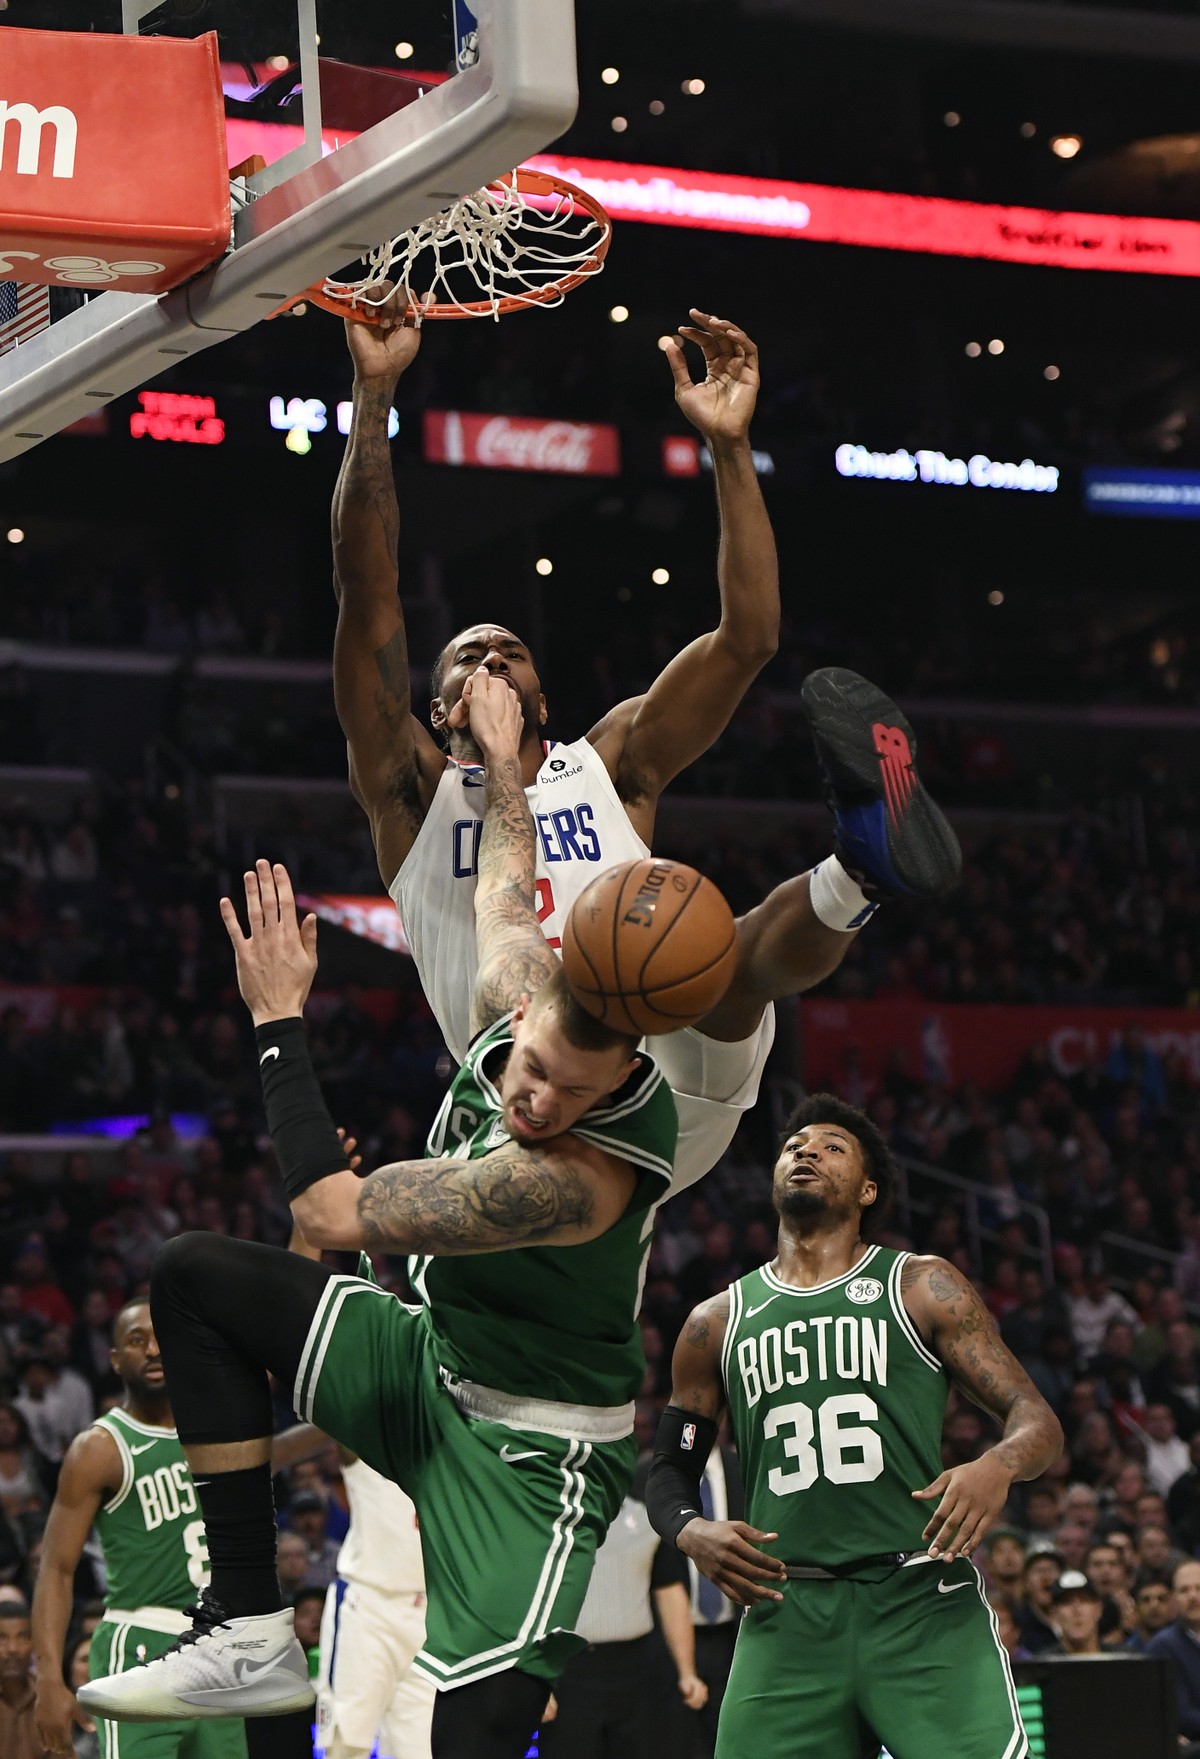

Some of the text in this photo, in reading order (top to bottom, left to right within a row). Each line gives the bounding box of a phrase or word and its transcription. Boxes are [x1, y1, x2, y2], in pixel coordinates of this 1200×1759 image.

[540, 765, 584, 784] bumble
[452, 802, 602, 879] CERS
[737, 1316, 888, 1410] BOSTON
[763, 1393, 885, 1497] 36
[135, 1460, 198, 1531] BOS
